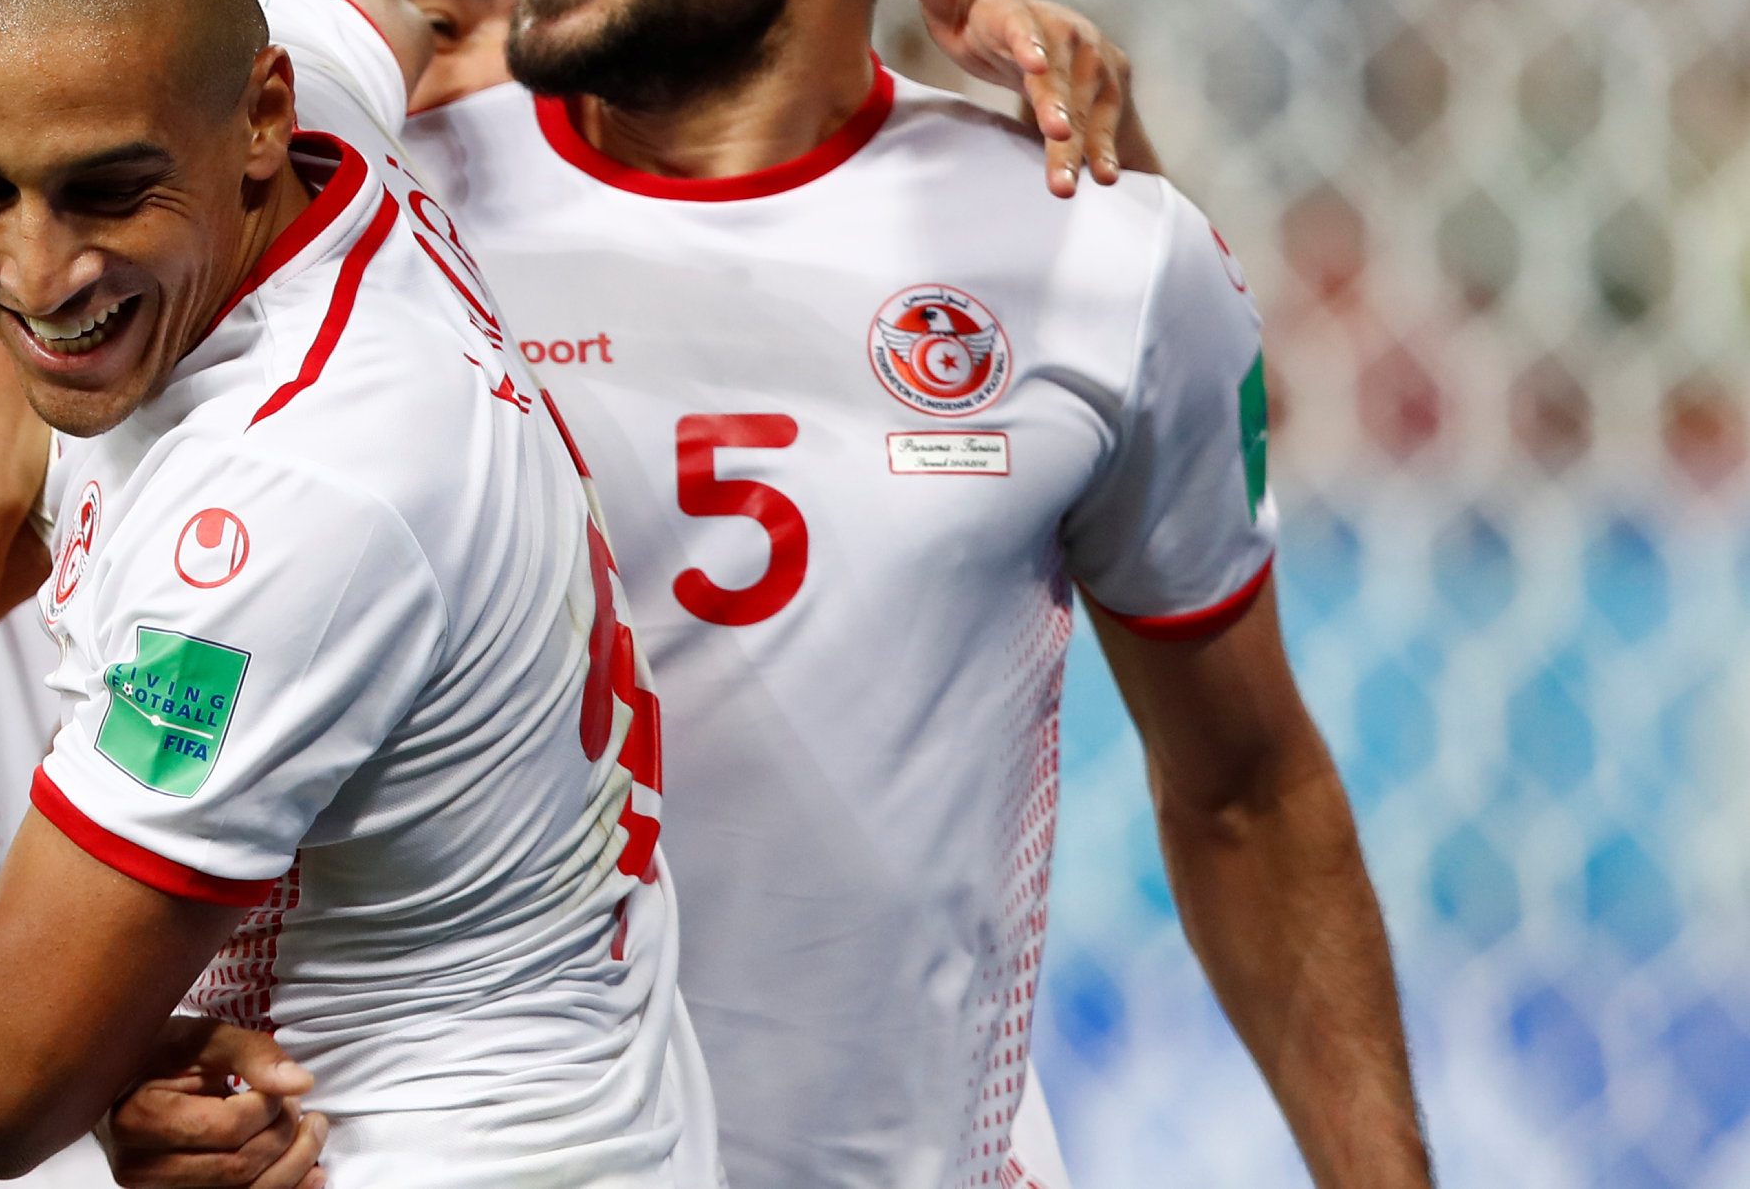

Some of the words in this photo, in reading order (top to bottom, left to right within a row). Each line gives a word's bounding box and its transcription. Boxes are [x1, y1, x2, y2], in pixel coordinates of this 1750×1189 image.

[898, 438, 951, 453] Panama
[960, 437, 1002, 453] Tunisia
[674, 413, 808, 626] 5
[111, 675, 218, 728] FOOTBALL
[115, 663, 226, 710] LIVING
[164, 735, 208, 762] FIFA
